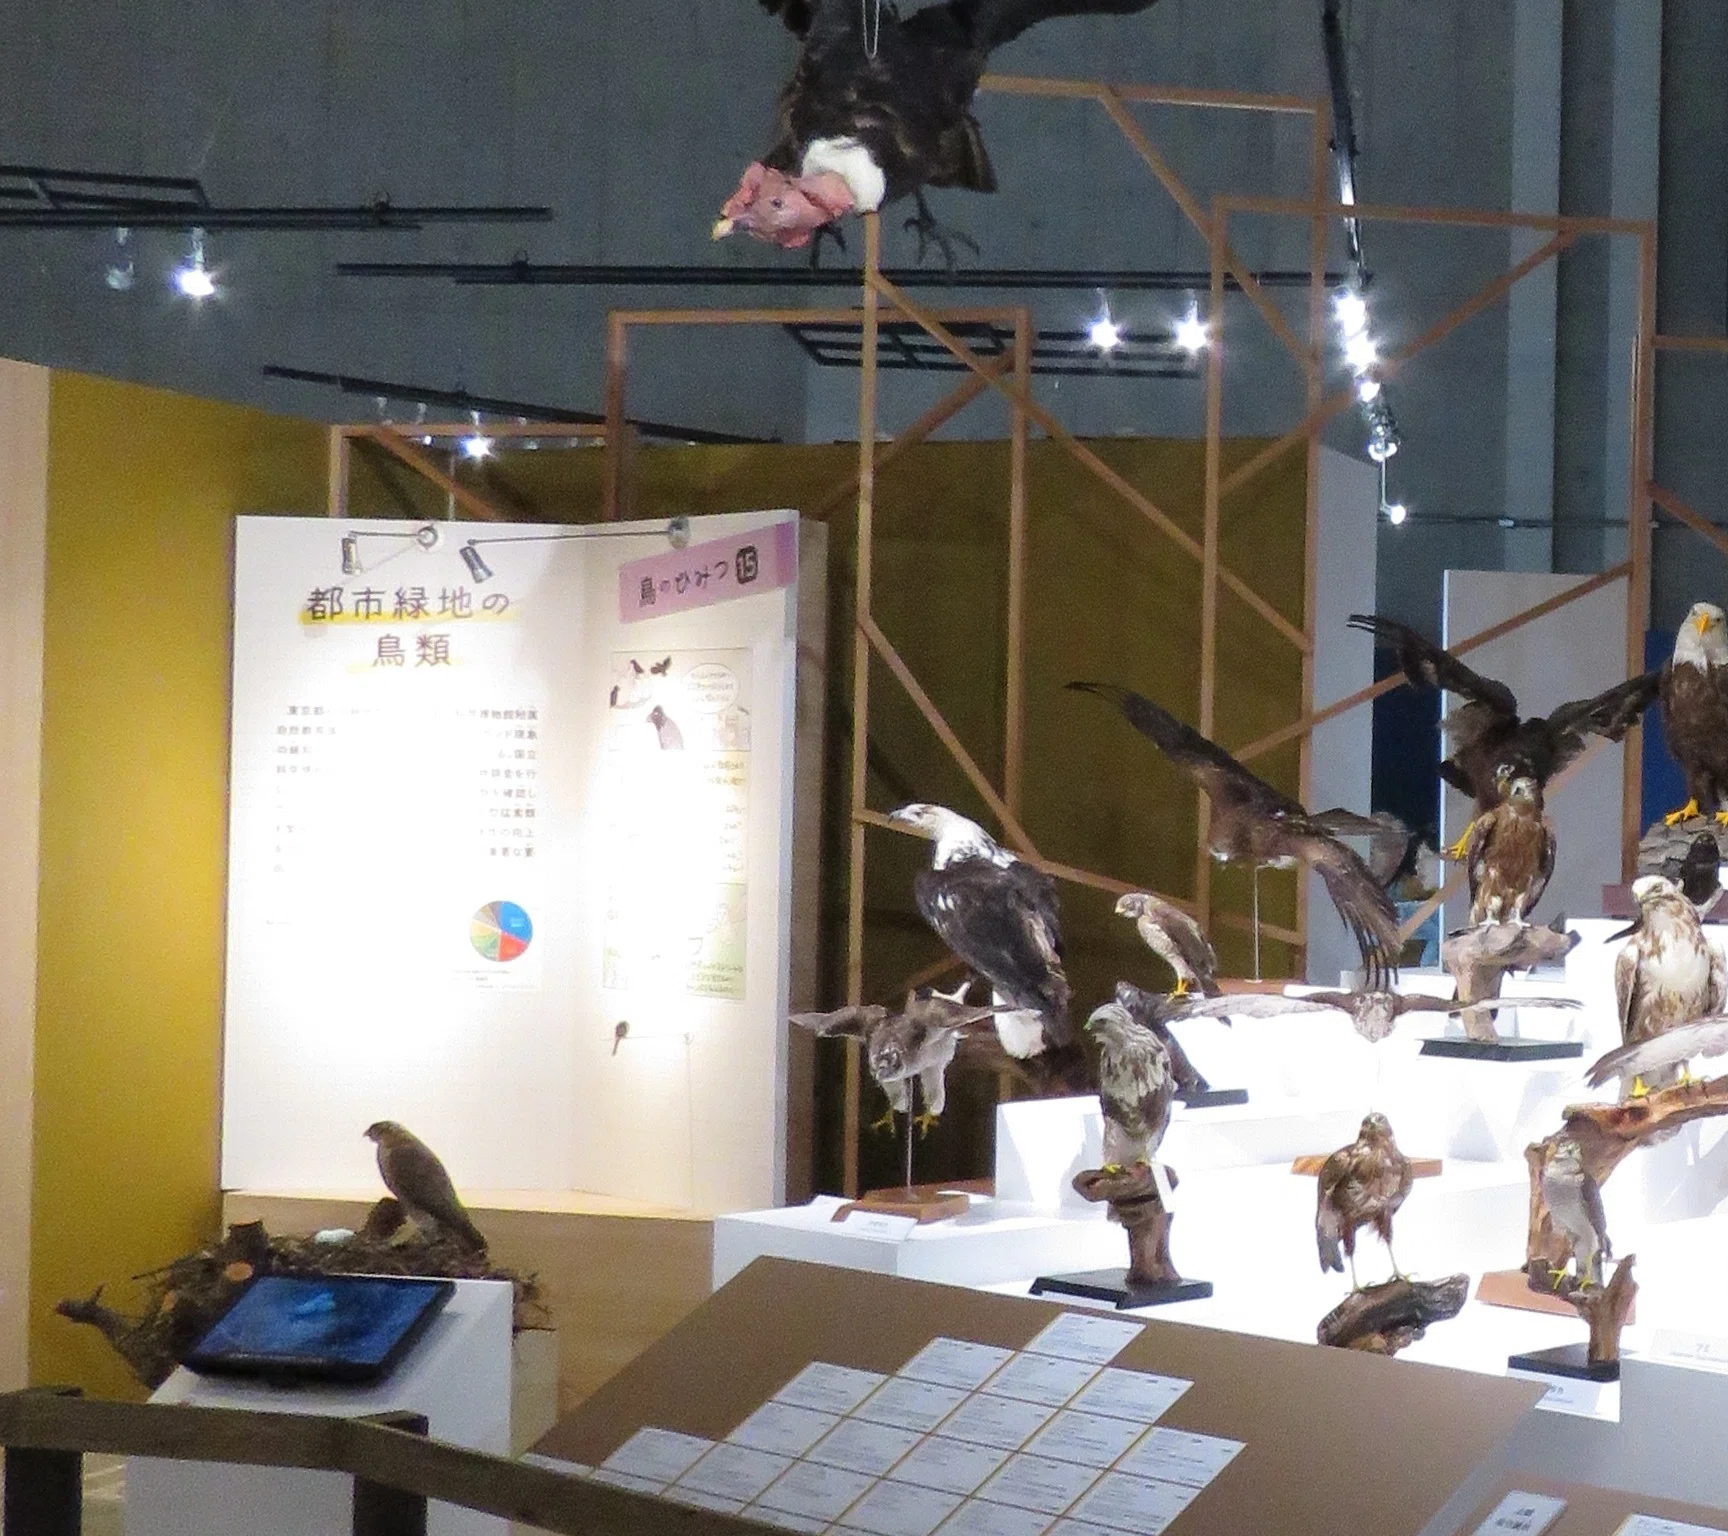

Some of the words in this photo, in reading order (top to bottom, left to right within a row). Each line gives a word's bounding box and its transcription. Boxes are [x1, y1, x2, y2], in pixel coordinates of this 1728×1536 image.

[637, 560, 730, 608] 鳥のひみつ
[306, 585, 511, 621] 都市緑地の
[371, 632, 453, 668] 鳥類
